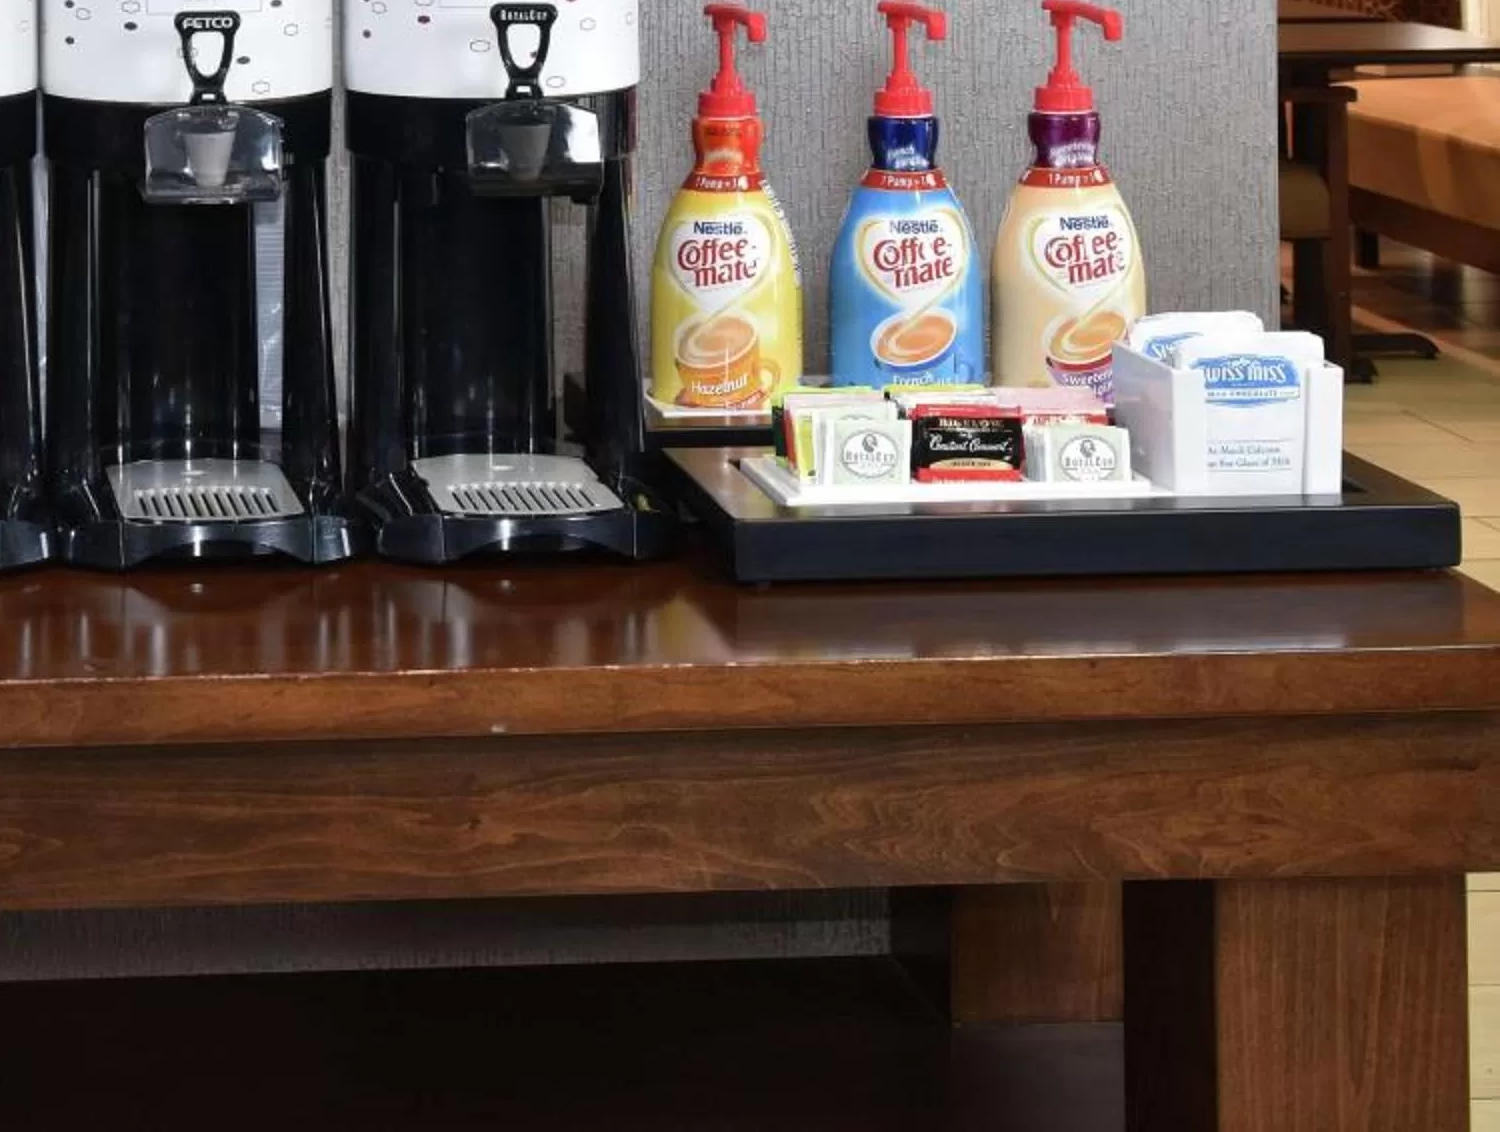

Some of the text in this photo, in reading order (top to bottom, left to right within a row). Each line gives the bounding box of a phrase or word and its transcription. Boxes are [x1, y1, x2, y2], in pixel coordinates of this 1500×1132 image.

[182, 17, 234, 29] FETCO
[894, 255, 954, 287] mate
[1204, 360, 1244, 382] wiss
[691, 373, 748, 395] Hazelnut
